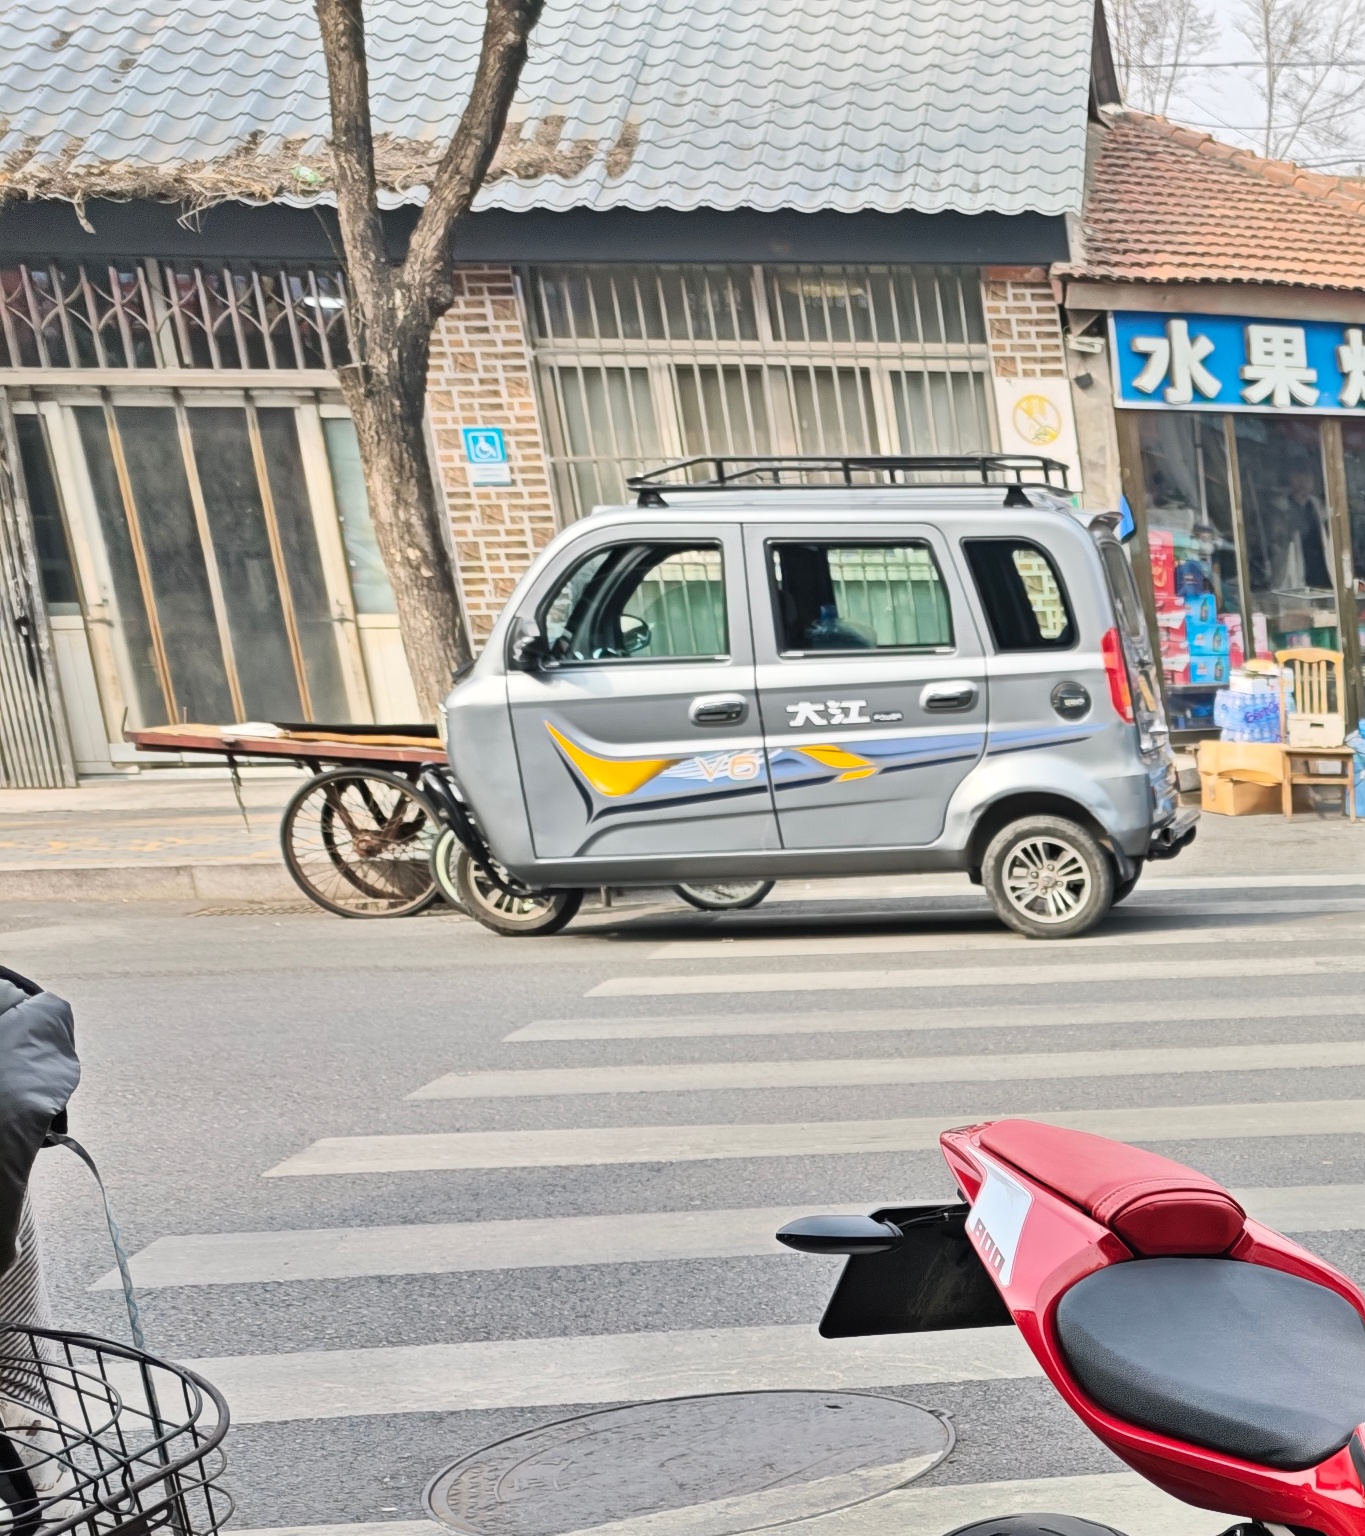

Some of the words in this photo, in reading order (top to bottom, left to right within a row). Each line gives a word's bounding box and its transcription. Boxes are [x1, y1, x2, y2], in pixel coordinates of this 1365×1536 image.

[785, 699, 872, 727] 大江
[694, 754, 760, 782] V6
[974, 1217, 1006, 1277] 800
